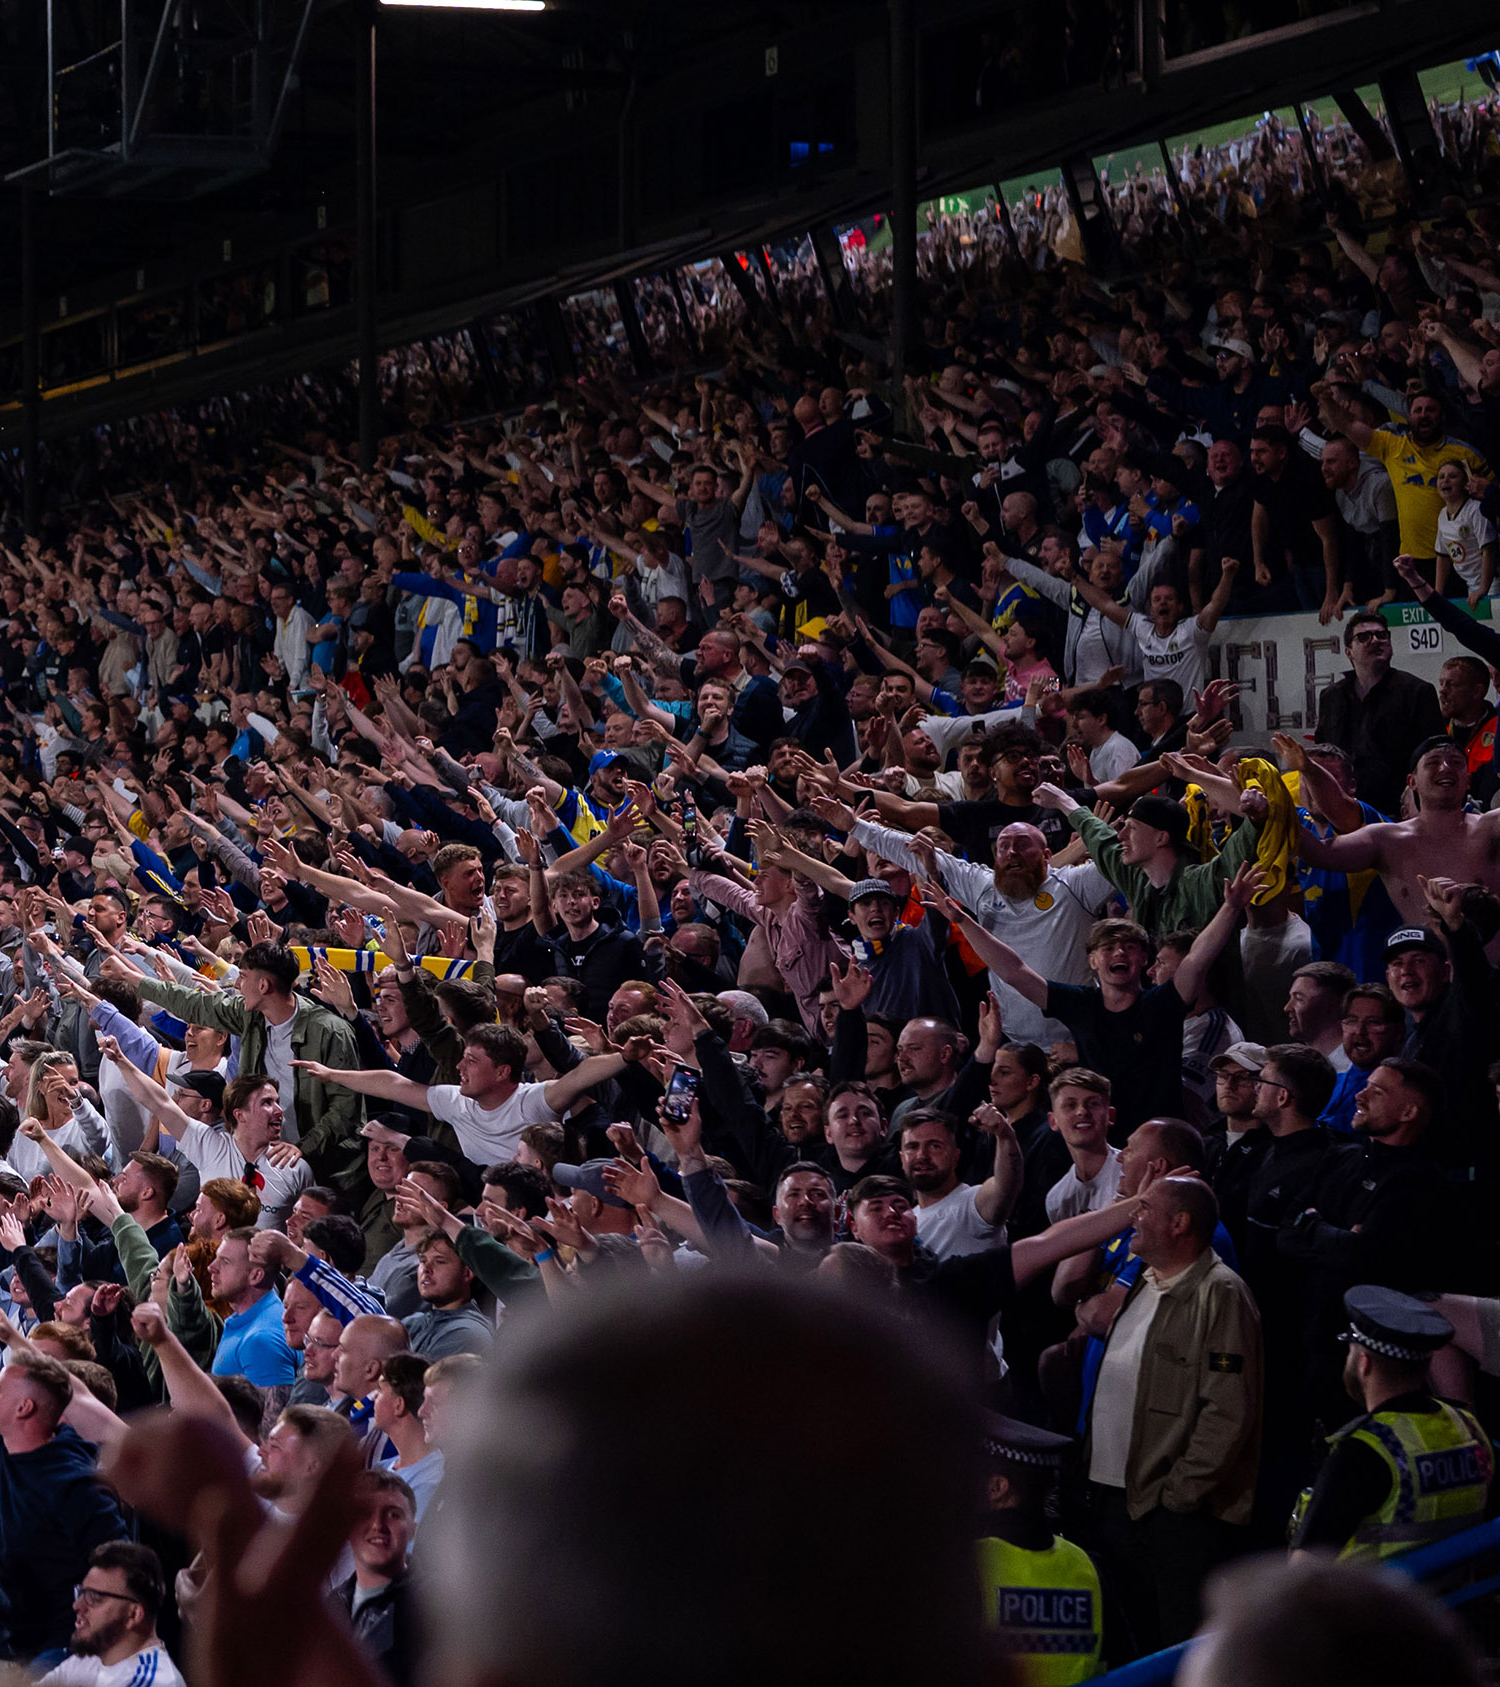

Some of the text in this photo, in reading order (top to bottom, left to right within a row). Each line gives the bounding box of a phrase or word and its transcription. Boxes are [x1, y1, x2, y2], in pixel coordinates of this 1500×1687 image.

[1402, 607, 1426, 624] EXIT
[1411, 628, 1440, 650] S4D
[1144, 652, 1184, 666] BOTOP
[1389, 931, 1422, 945] PING
[1004, 1592, 1089, 1625] POLICE
